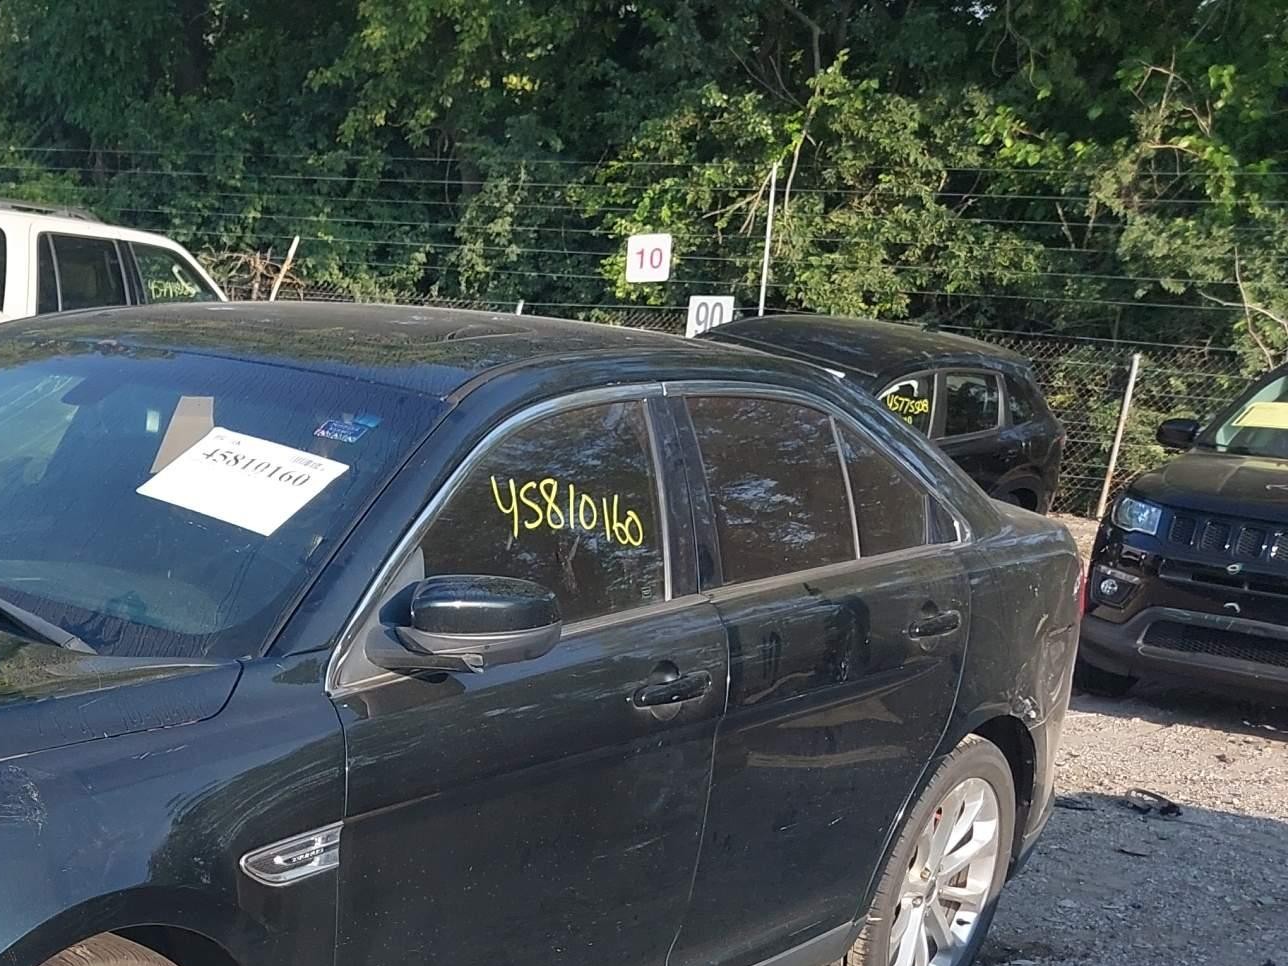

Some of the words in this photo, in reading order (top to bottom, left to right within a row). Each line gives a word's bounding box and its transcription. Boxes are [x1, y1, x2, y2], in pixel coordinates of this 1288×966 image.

[636, 247, 663, 269] 10
[202, 447, 311, 487] 45810160
[490, 475, 644, 547] 45810160
